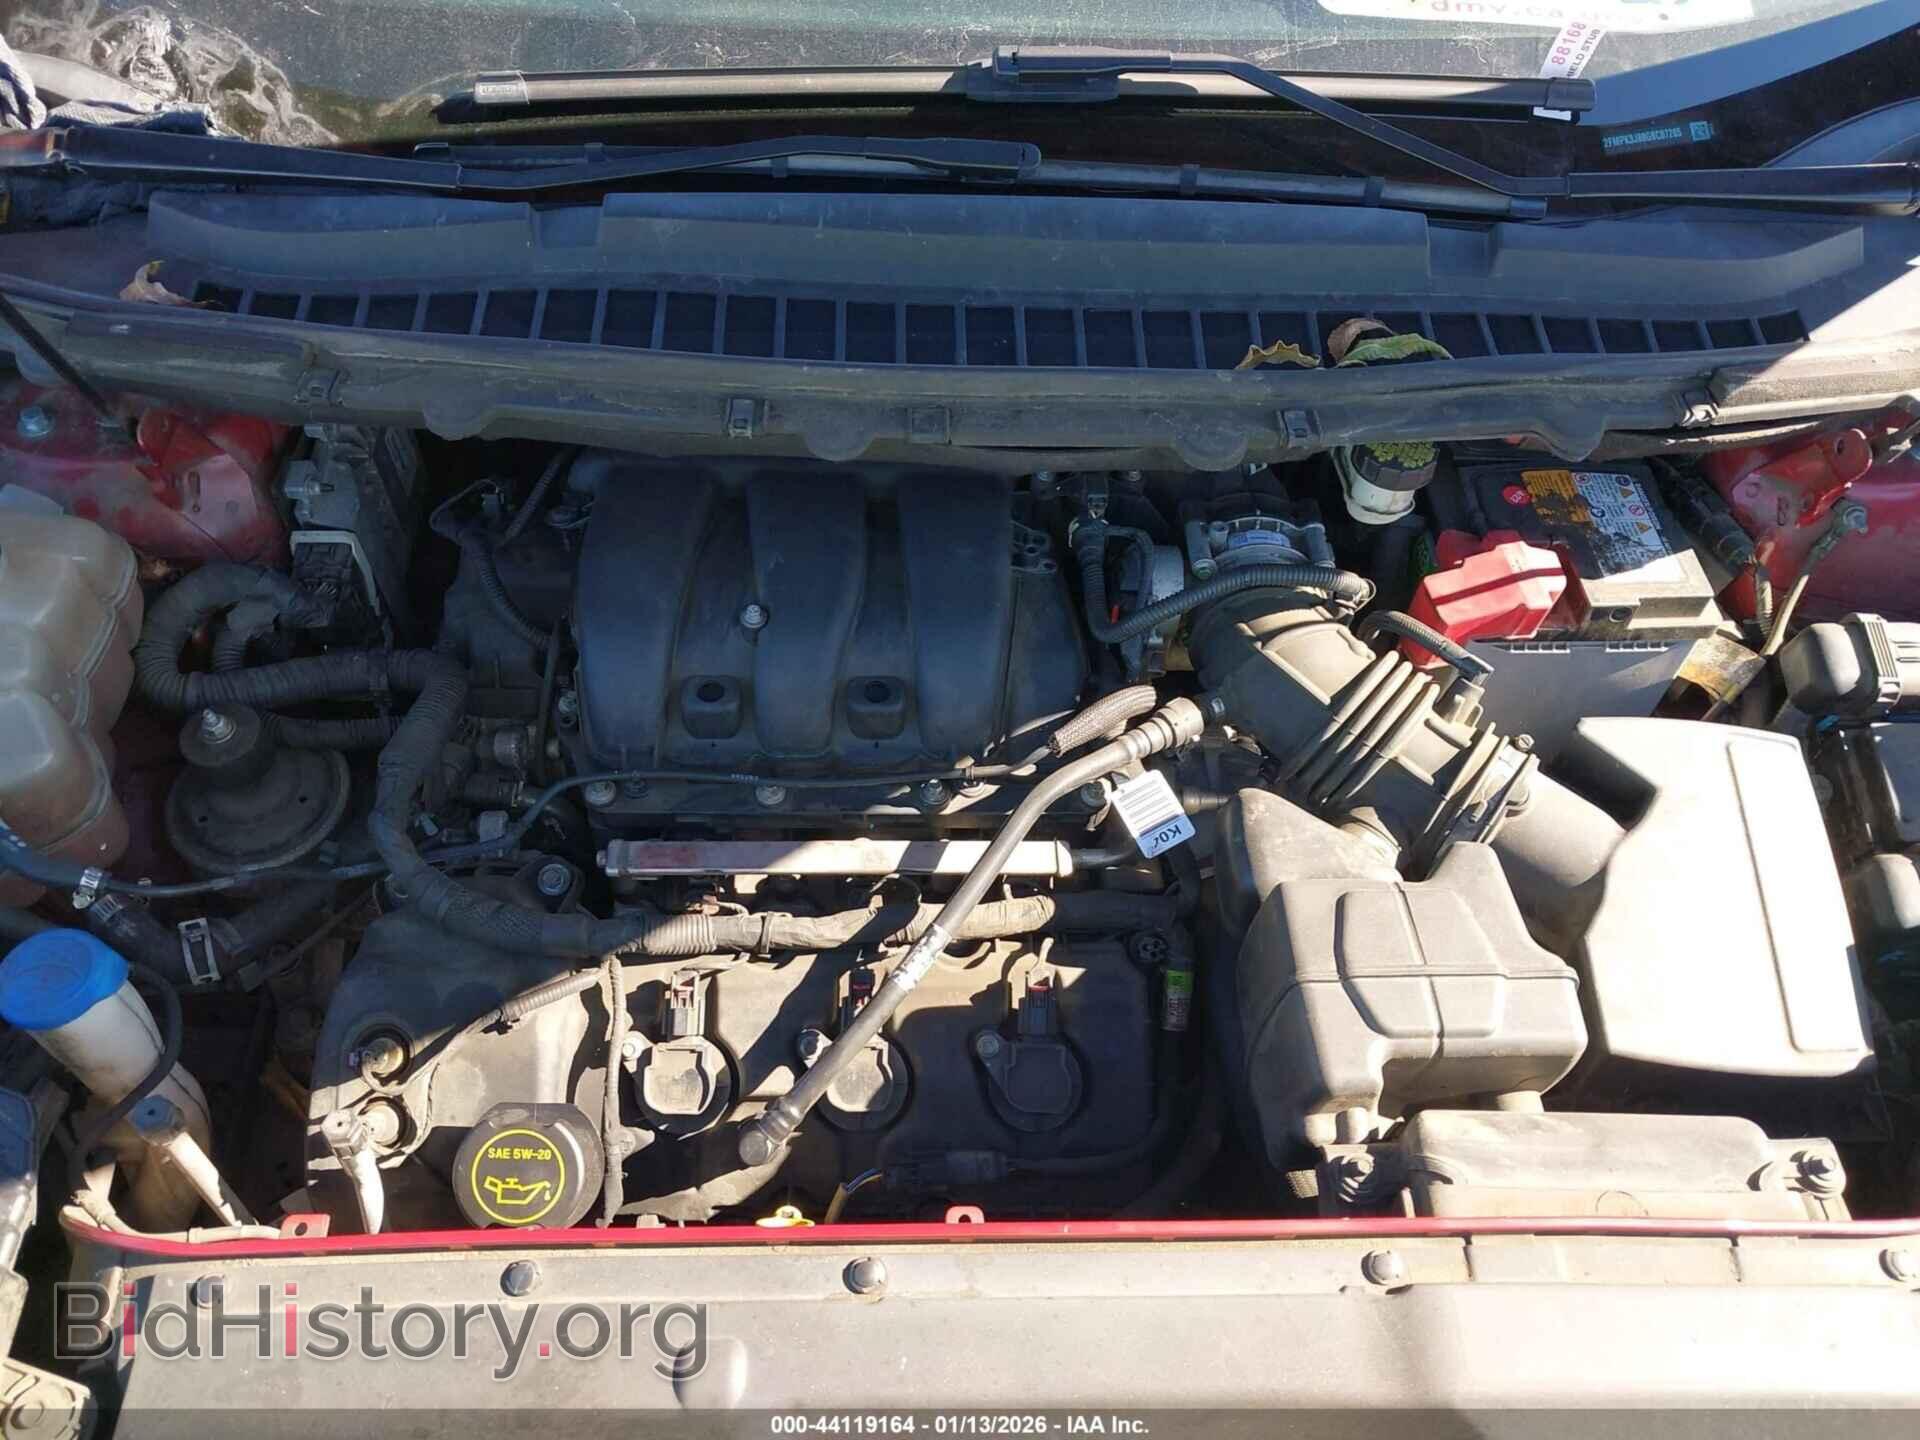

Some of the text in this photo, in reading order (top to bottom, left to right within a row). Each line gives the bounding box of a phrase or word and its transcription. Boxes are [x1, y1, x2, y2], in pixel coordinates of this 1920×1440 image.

[1551, 22, 1586, 65] 88168
[487, 1148, 552, 1161] SAE 5W-20
